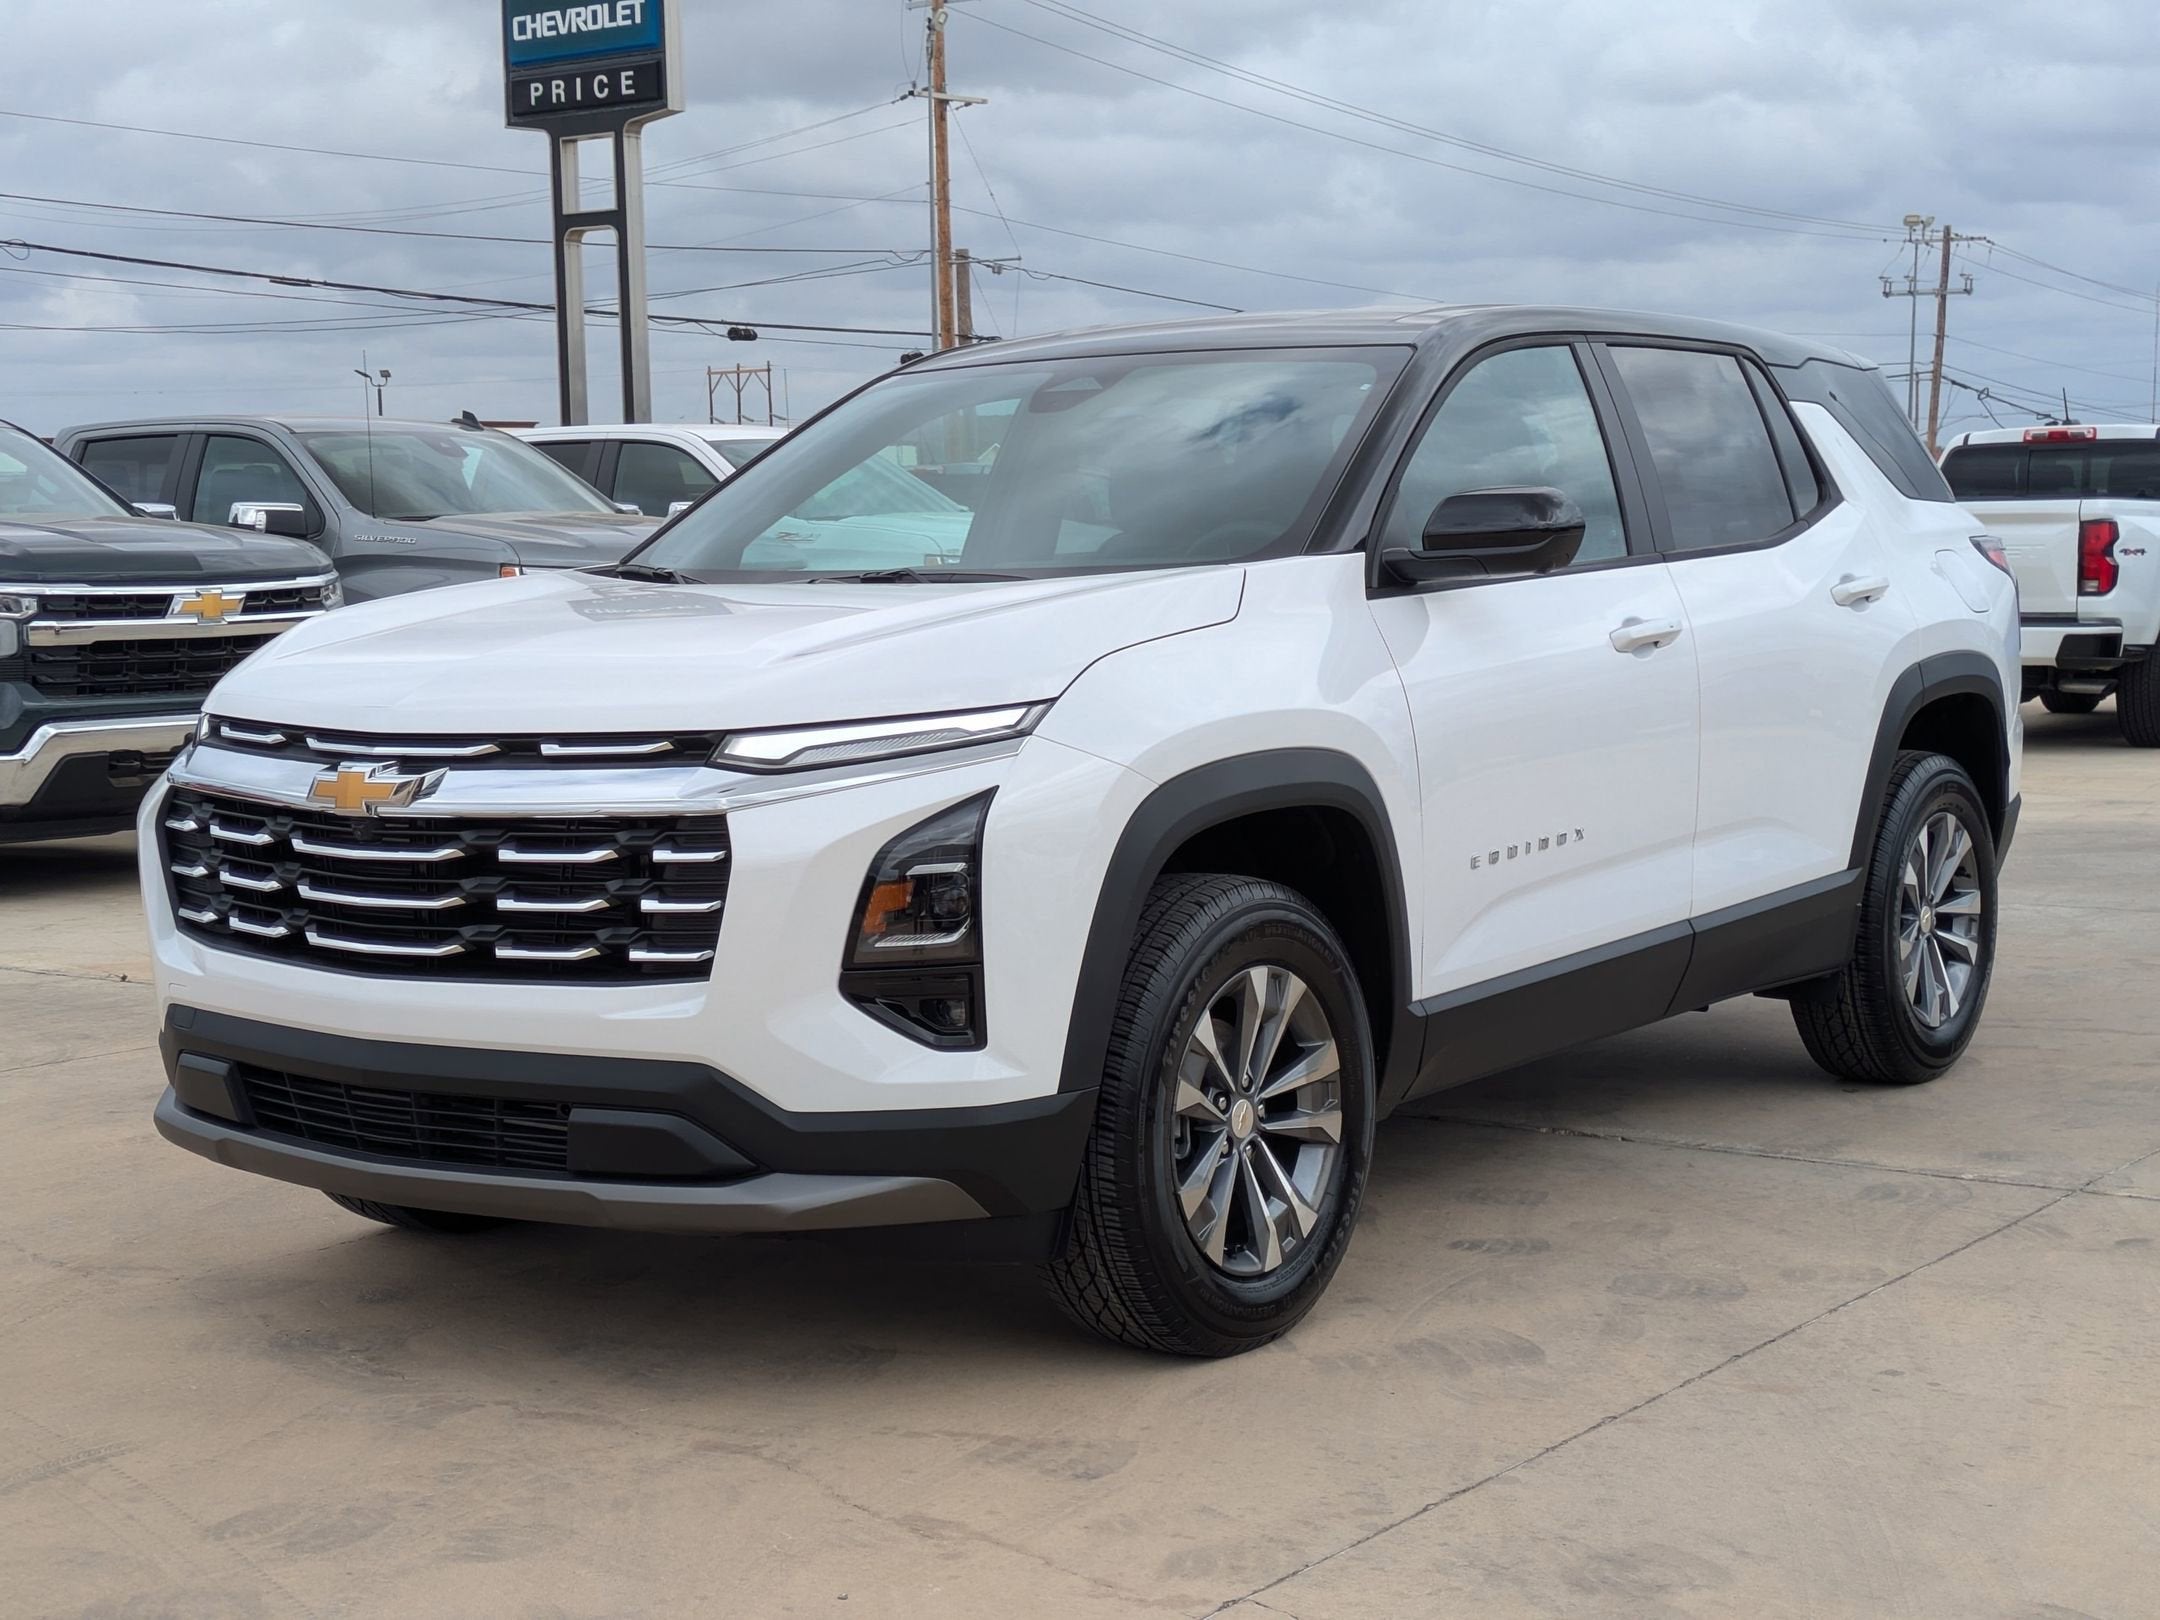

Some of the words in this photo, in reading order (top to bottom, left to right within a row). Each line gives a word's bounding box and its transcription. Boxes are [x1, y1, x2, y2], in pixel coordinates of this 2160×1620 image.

[512, 0, 645, 41] CHEVROLET
[530, 71, 635, 106] PRICE
[353, 534, 417, 544] SILVERADO
[1470, 827, 1584, 870] EQUINOX
